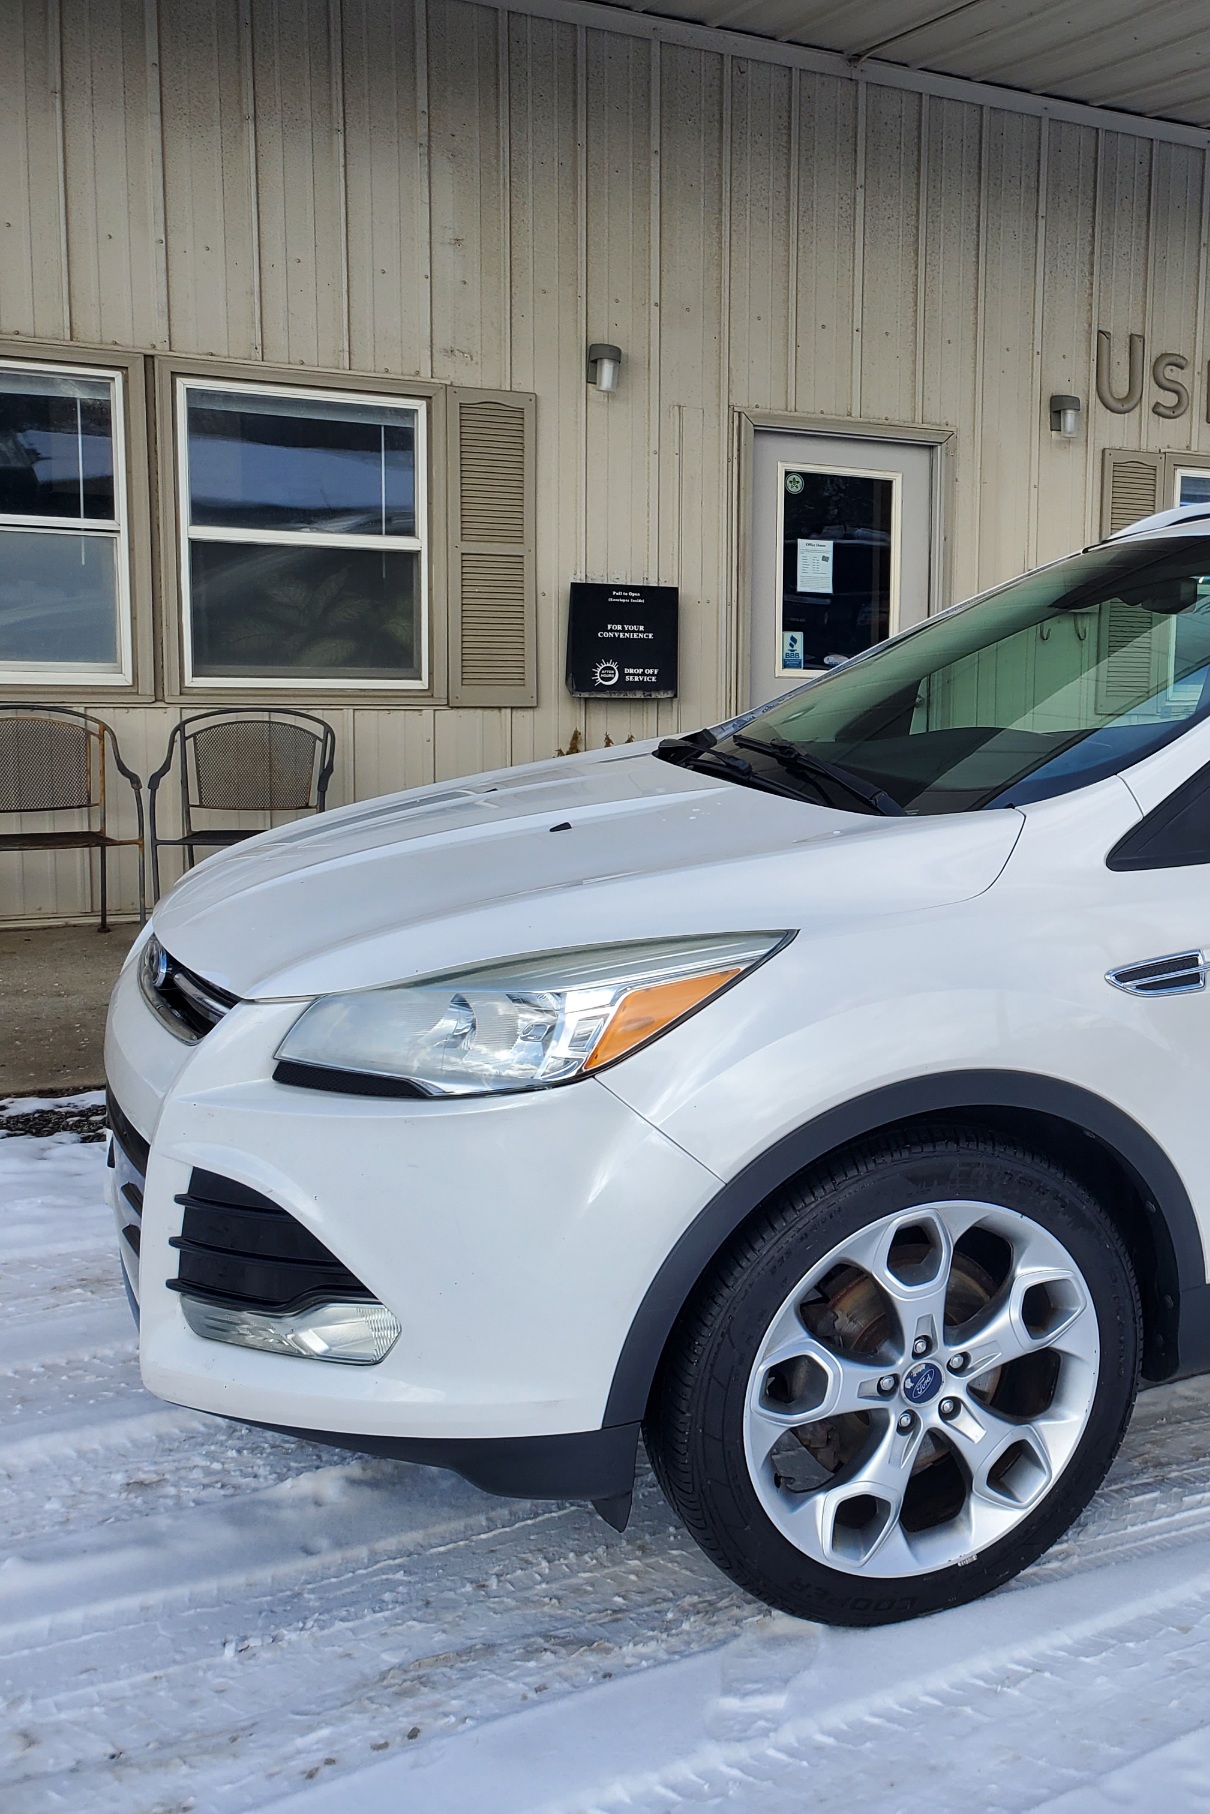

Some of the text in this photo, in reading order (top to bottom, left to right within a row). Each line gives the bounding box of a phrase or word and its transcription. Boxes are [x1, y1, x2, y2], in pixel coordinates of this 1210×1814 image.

[623, 624, 645, 632] YOUR
[597, 631, 654, 639] CONVENIENCE
[915, 1372, 932, 1395] Ford
